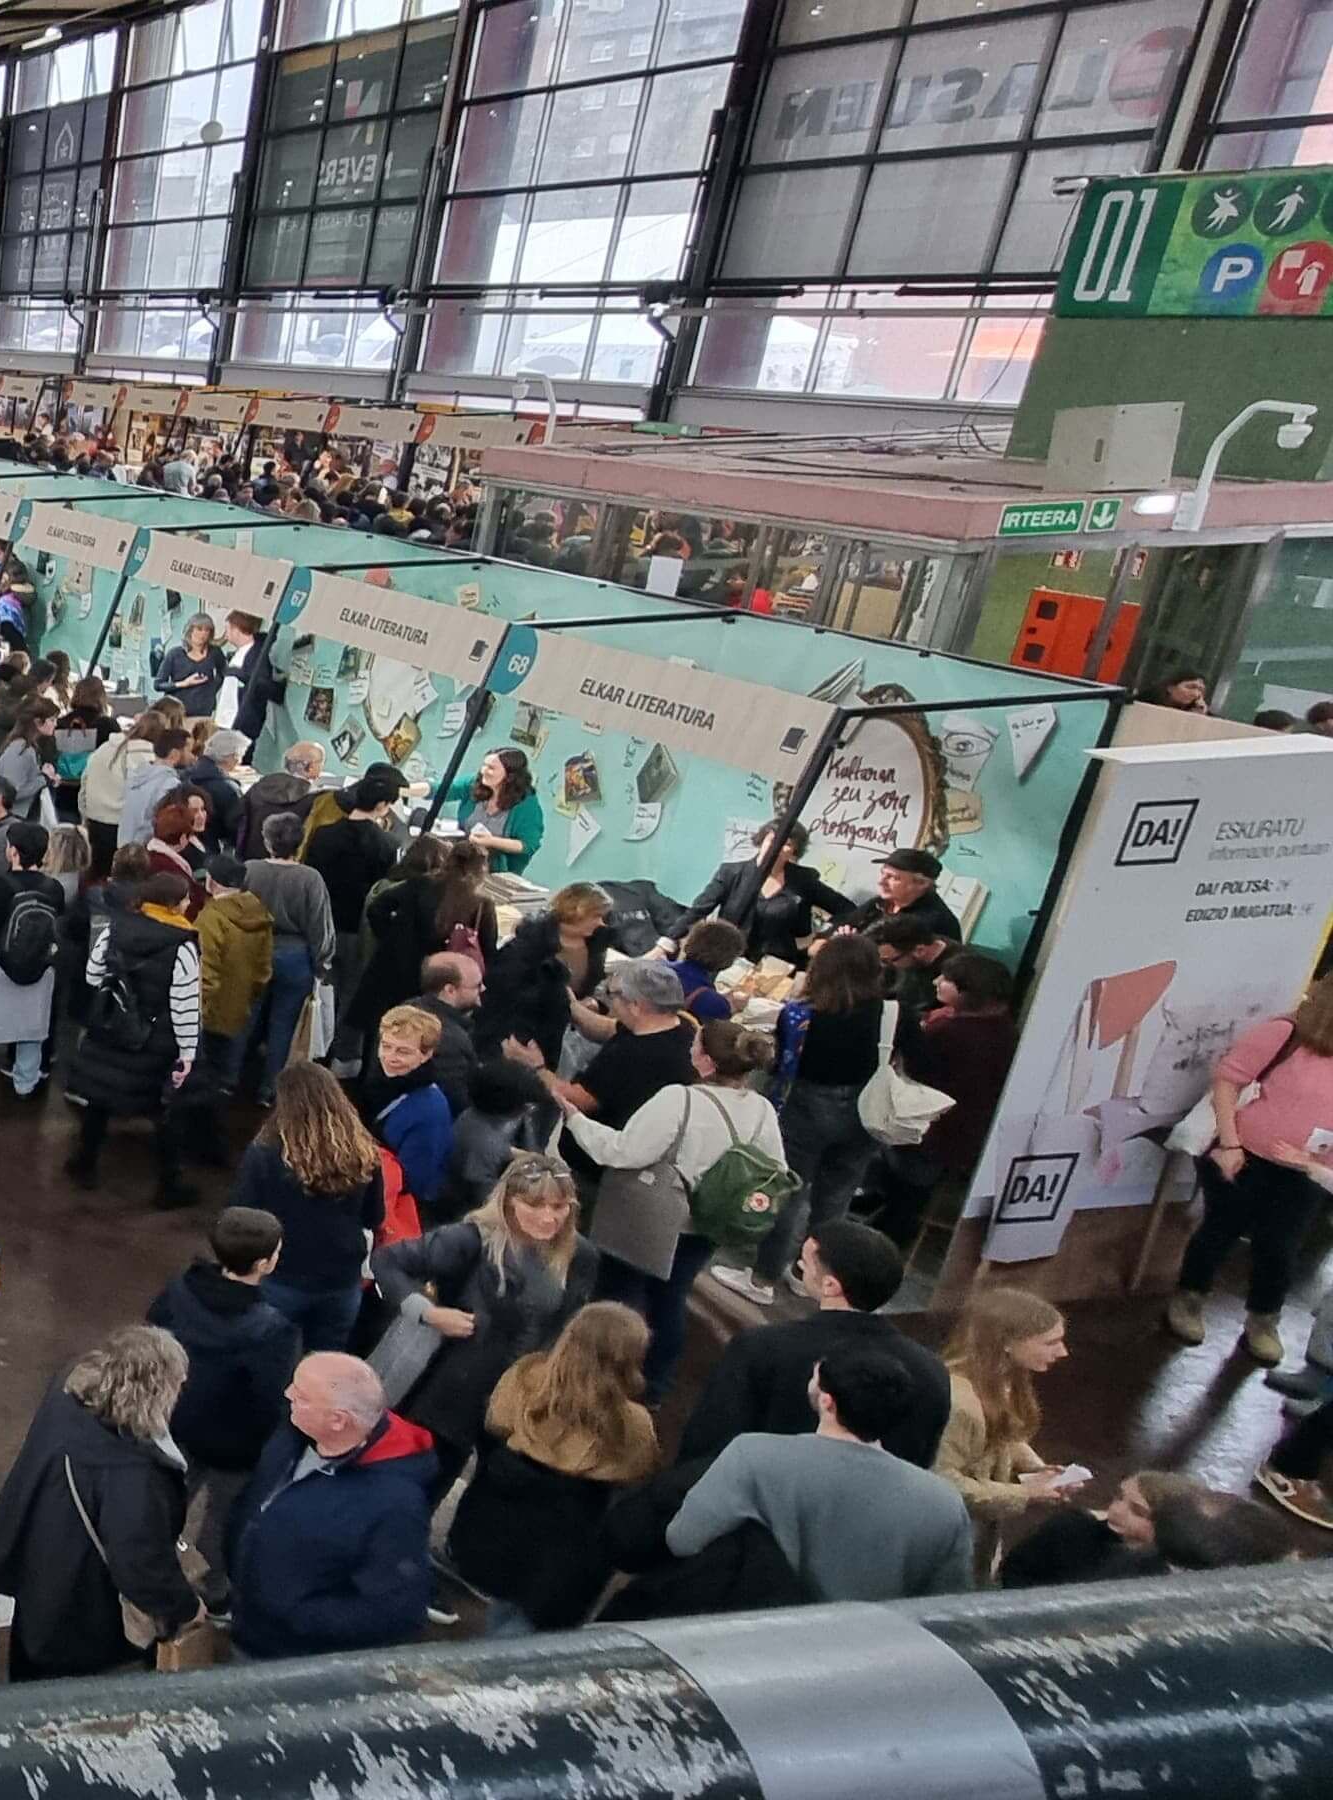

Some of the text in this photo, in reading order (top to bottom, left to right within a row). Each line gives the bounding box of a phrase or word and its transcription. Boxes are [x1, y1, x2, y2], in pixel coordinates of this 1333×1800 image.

[1072, 187, 1158, 302] 01
[1002, 509, 1077, 529] IRTEERA
[169, 559, 236, 588] ELKAR LITERATURA
[291, 589, 307, 608] 67
[339, 606, 429, 646] ELKAR LITERATURA
[507, 653, 530, 675] 68
[579, 677, 716, 731] ELKAR LITERATURA
[1132, 818, 1182, 848] DA!
[1215, 818, 1307, 841] ESKURATU
[1008, 1173, 1060, 1206] DA!
